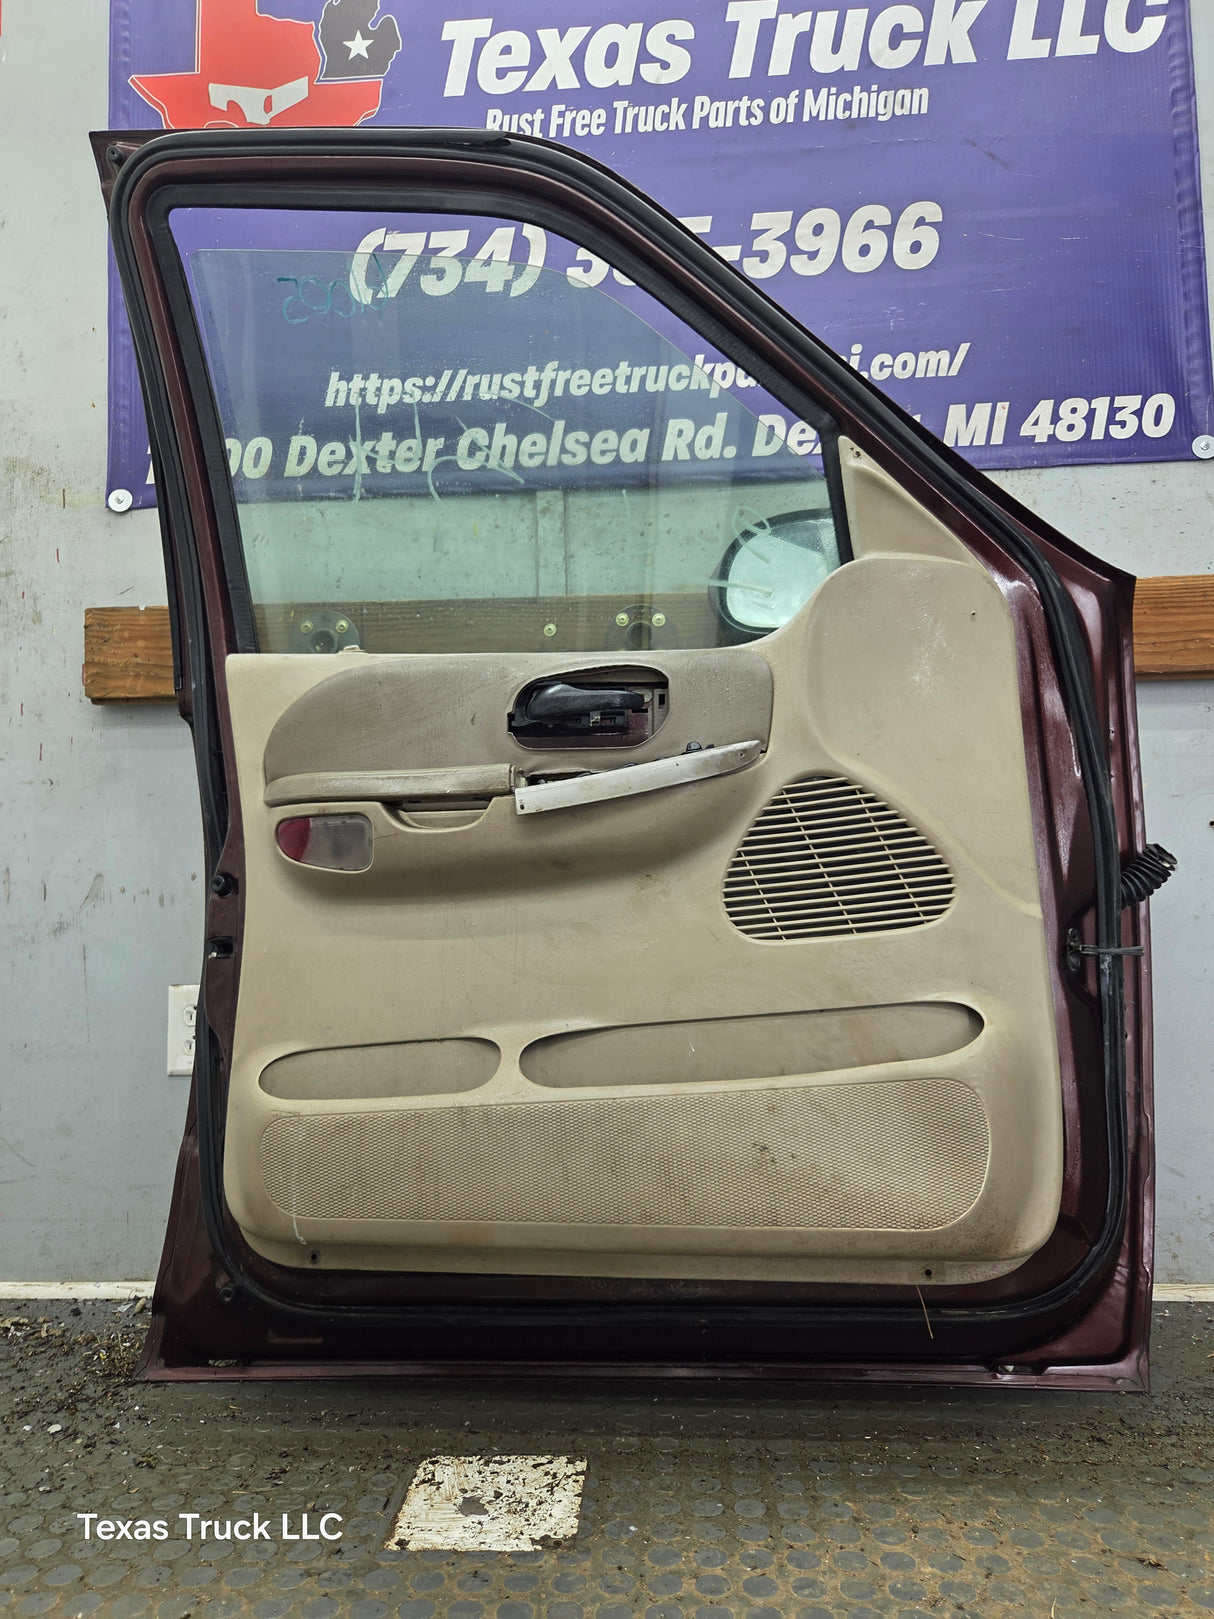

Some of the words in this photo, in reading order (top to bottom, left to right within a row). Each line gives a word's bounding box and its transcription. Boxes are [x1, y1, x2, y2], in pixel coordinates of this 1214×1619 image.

[441, 18, 695, 97] Texas
[725, 0, 988, 79] Truck
[1006, 0, 1169, 61] LLC
[486, 108, 545, 138] Rust
[550, 104, 606, 138] Free
[612, 97, 688, 134] Truck
[691, 95, 764, 129] Parts
[769, 89, 799, 124] of
[802, 84, 929, 122] Michigan
[349, 222, 547, 305] (734)
[283, 432, 443, 477] Dexter
[456, 420, 648, 468] Chelsea
[661, 412, 737, 461] Rd.
[943, 402, 1010, 447] MI
[1020, 393, 1176, 442] 48130
